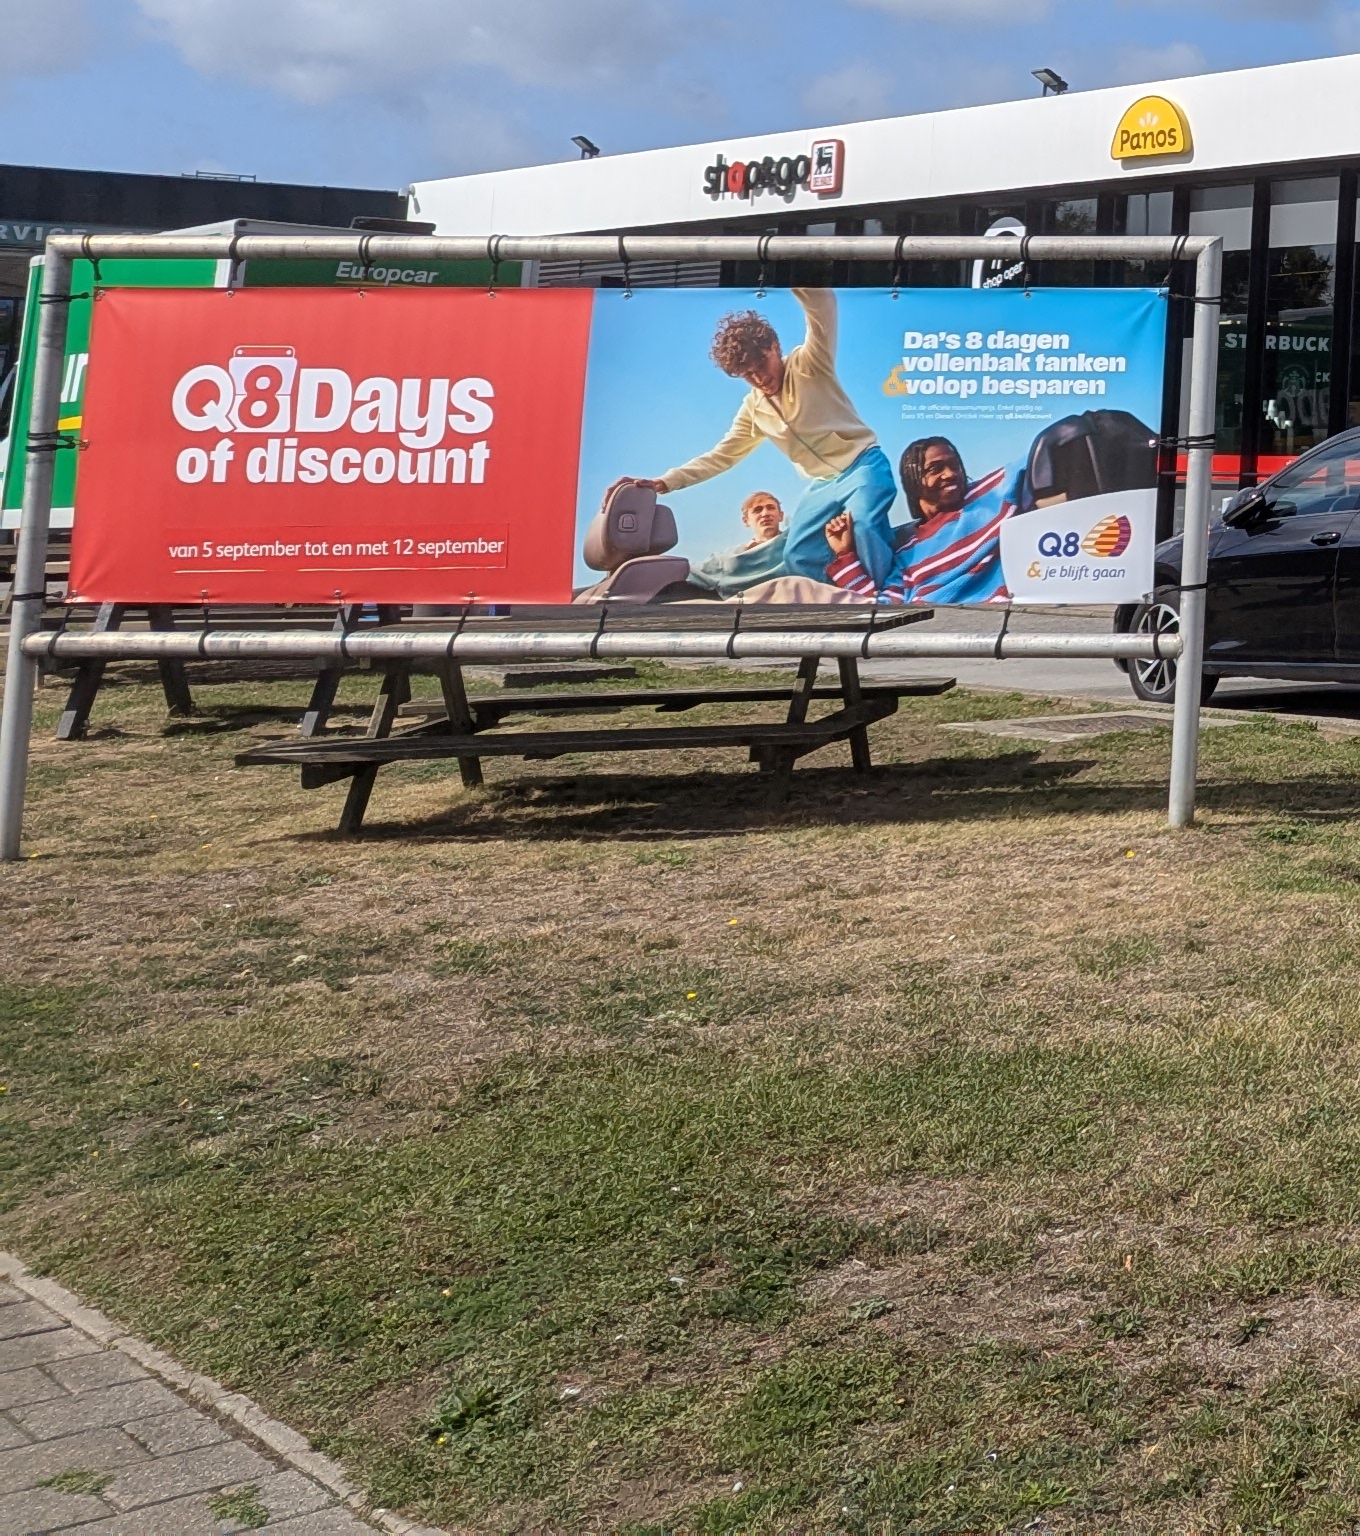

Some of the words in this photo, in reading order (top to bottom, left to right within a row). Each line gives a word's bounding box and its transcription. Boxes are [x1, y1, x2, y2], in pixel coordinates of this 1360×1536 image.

[1120, 127, 1177, 152] Panos
[336, 261, 439, 286] Europcar
[965, 331, 983, 350] 8
[986, 330, 1070, 354] dagen
[902, 353, 1031, 372] vollenbak
[1035, 353, 1126, 372] tanken
[906, 376, 978, 399] volop
[982, 375, 1106, 399] besparen
[176, 438, 235, 484] of
[245, 438, 490, 484] discount
[168, 544, 198, 558] van
[202, 542, 213, 557] 5
[216, 540, 302, 561] september
[304, 541, 330, 556] tot
[332, 543, 353, 556] en
[356, 541, 389, 555] met
[392, 539, 414, 555] 12
[417, 538, 505, 558] september
[1038, 531, 1080, 557] Q8
[1042, 566, 1057, 581] je
[1059, 565, 1089, 581] blijft
[1092, 568, 1126, 581] gaan
